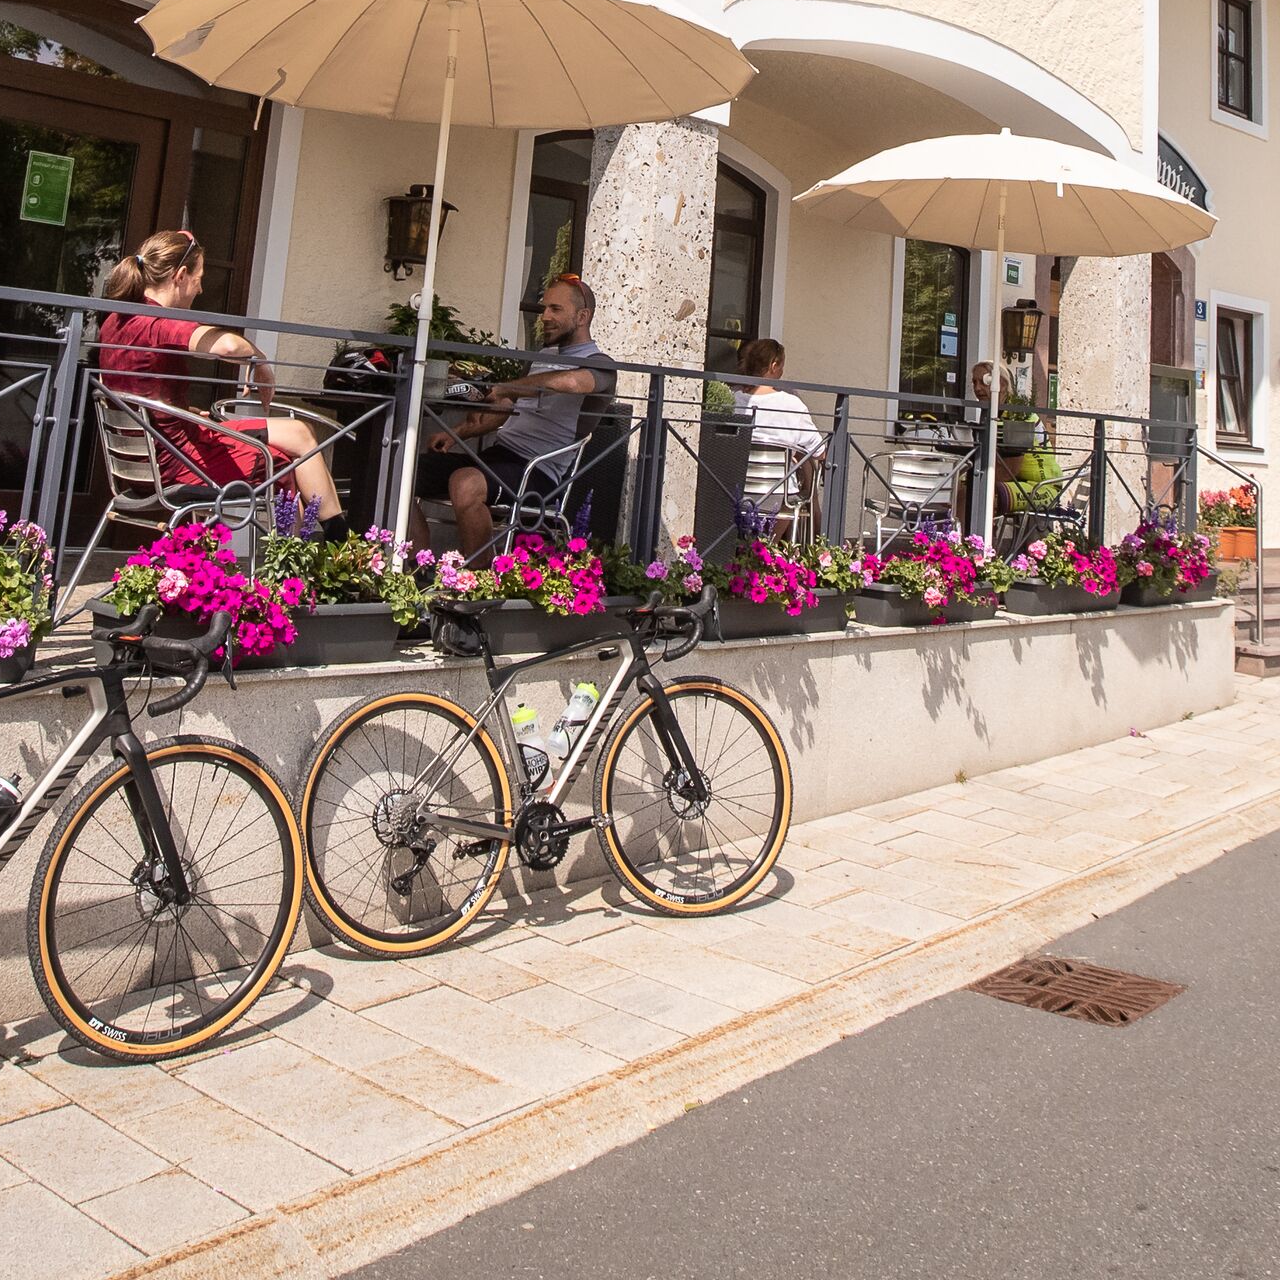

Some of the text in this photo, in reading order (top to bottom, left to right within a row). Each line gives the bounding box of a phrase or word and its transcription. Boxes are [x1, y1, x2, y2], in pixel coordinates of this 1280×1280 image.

[1197, 302, 1203, 314] 3
[88, 1017, 104, 1031] DT
[102, 1025, 128, 1042] SWISS
